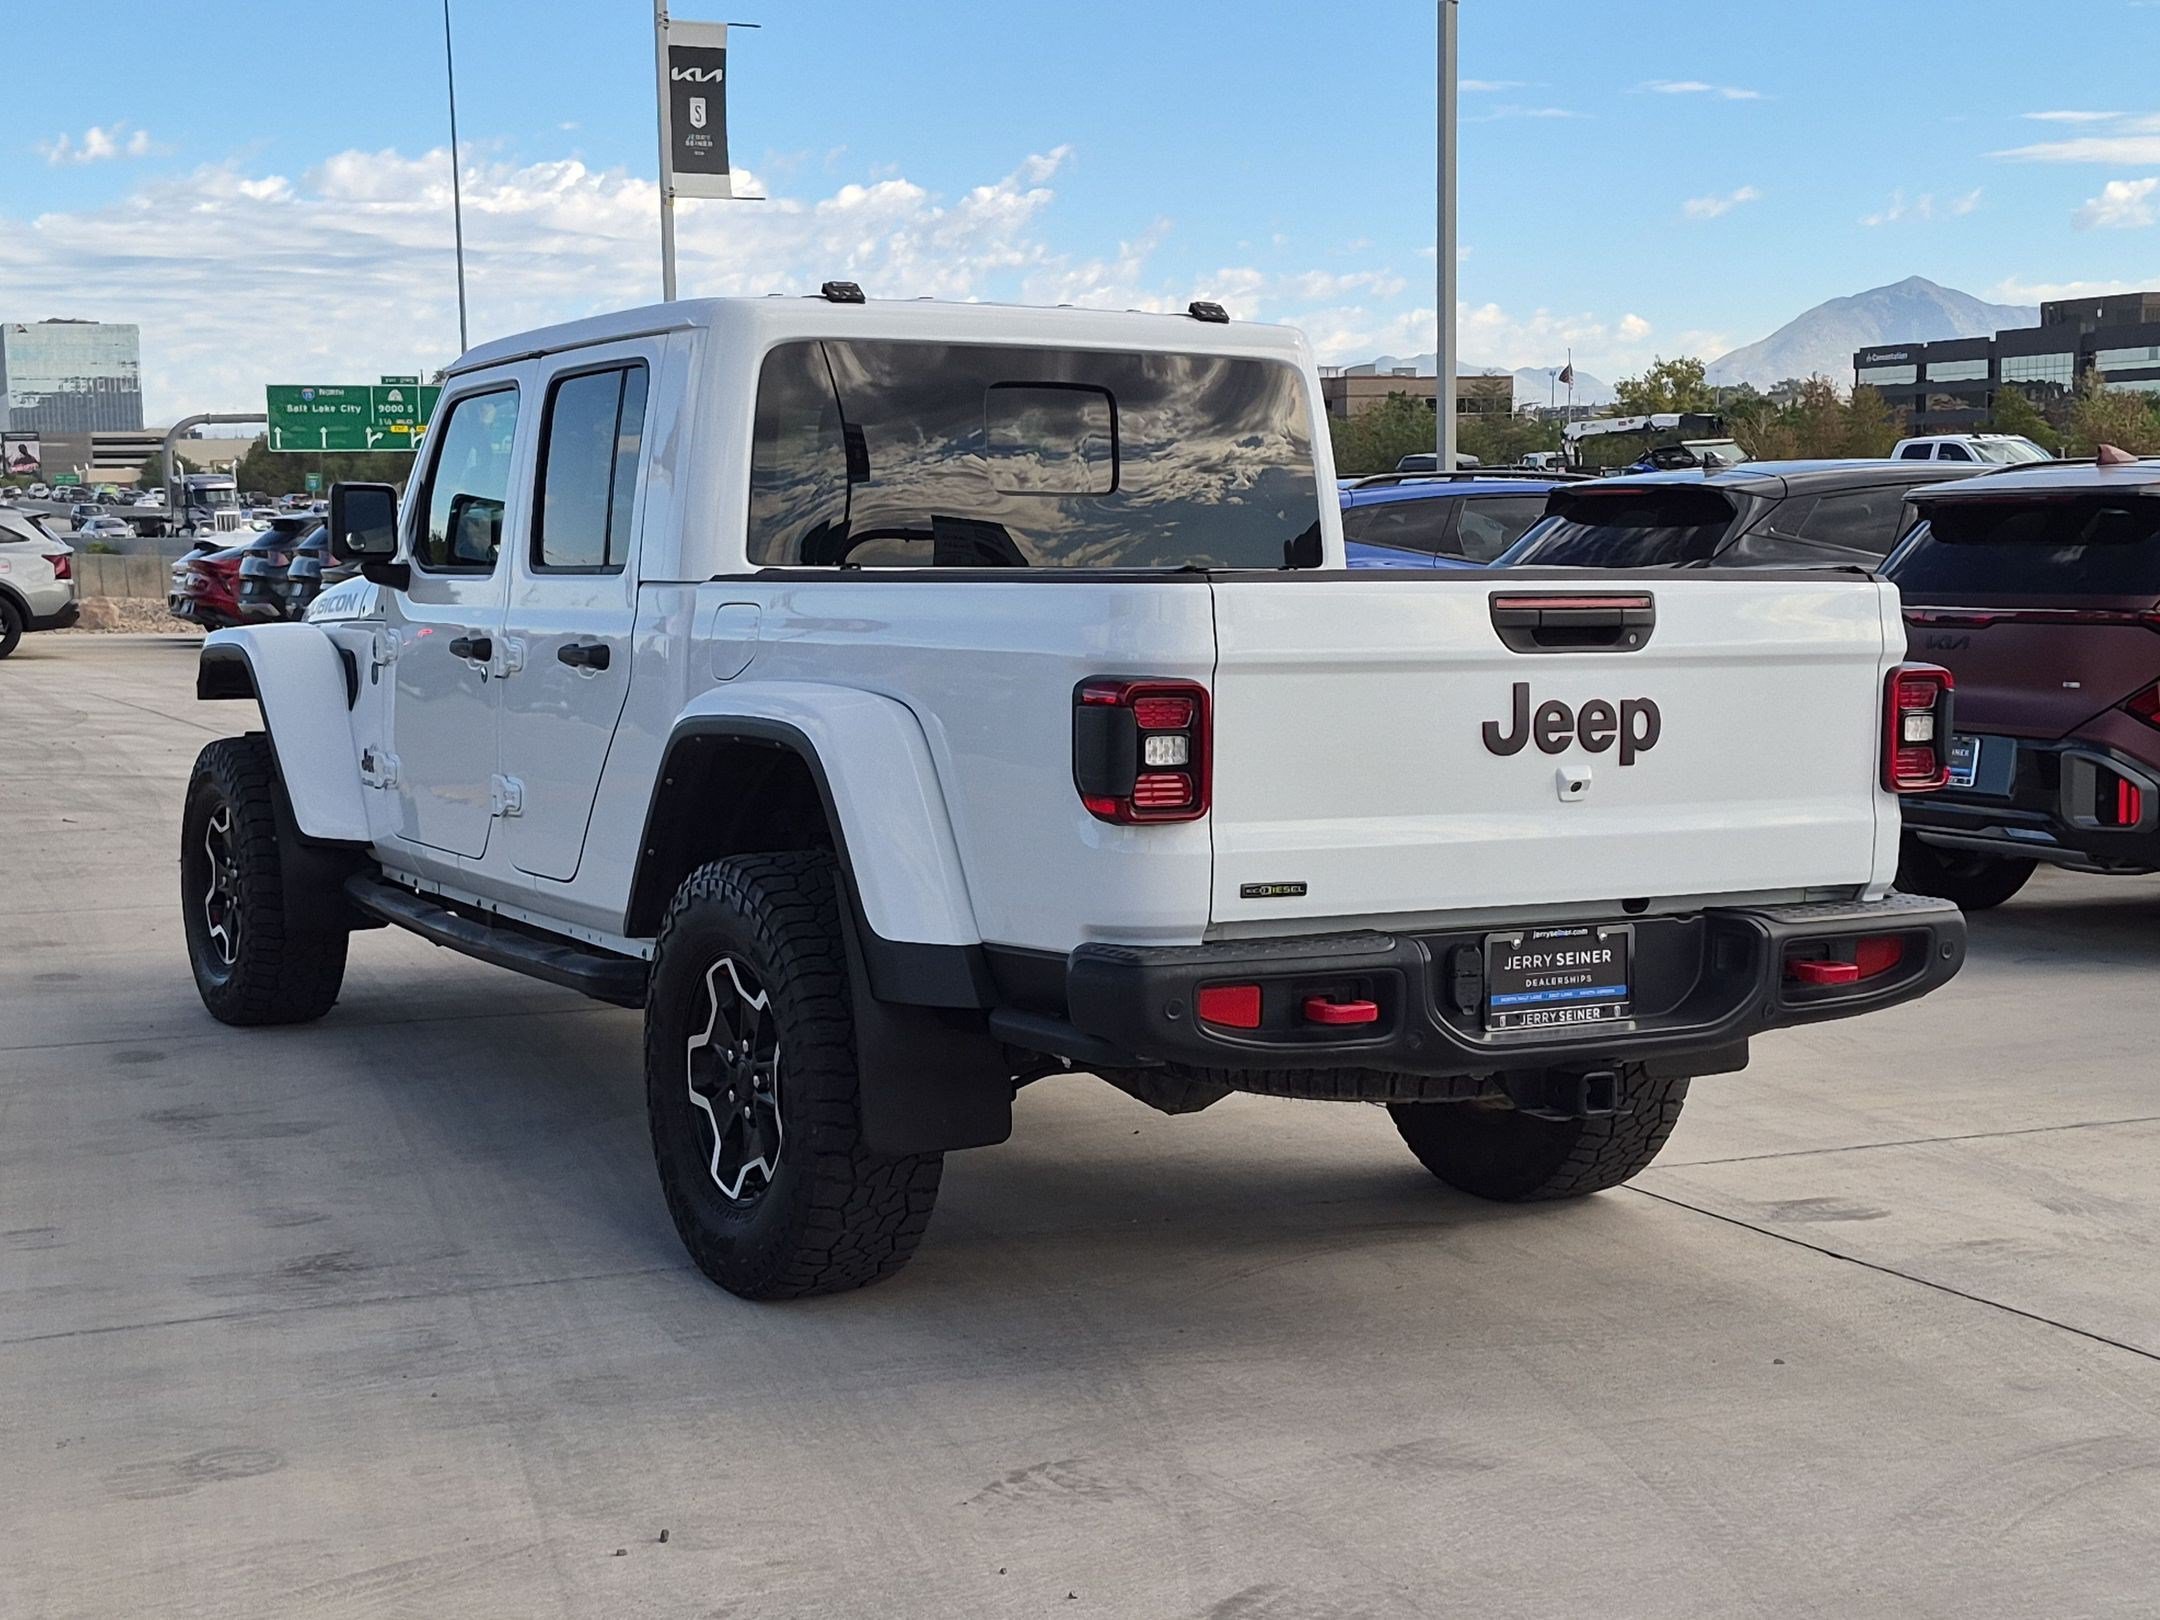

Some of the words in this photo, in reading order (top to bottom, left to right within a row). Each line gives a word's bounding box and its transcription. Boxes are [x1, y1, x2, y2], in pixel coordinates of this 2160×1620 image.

[671, 66, 723, 83] KIA
[286, 404, 307, 413] Salt
[312, 404, 336, 413] Lake
[340, 404, 362, 414] City
[378, 404, 404, 413] 9000
[310, 592, 358, 615] UBICON
[1482, 682, 1662, 767] Jeep
[1504, 953, 1553, 970] JERRY
[1556, 949, 1612, 966] SEINER
[1525, 974, 1593, 988] DEALERSHIPS
[1520, 1011, 1557, 1026] JERRY
[1558, 1007, 1601, 1022] SEINER
